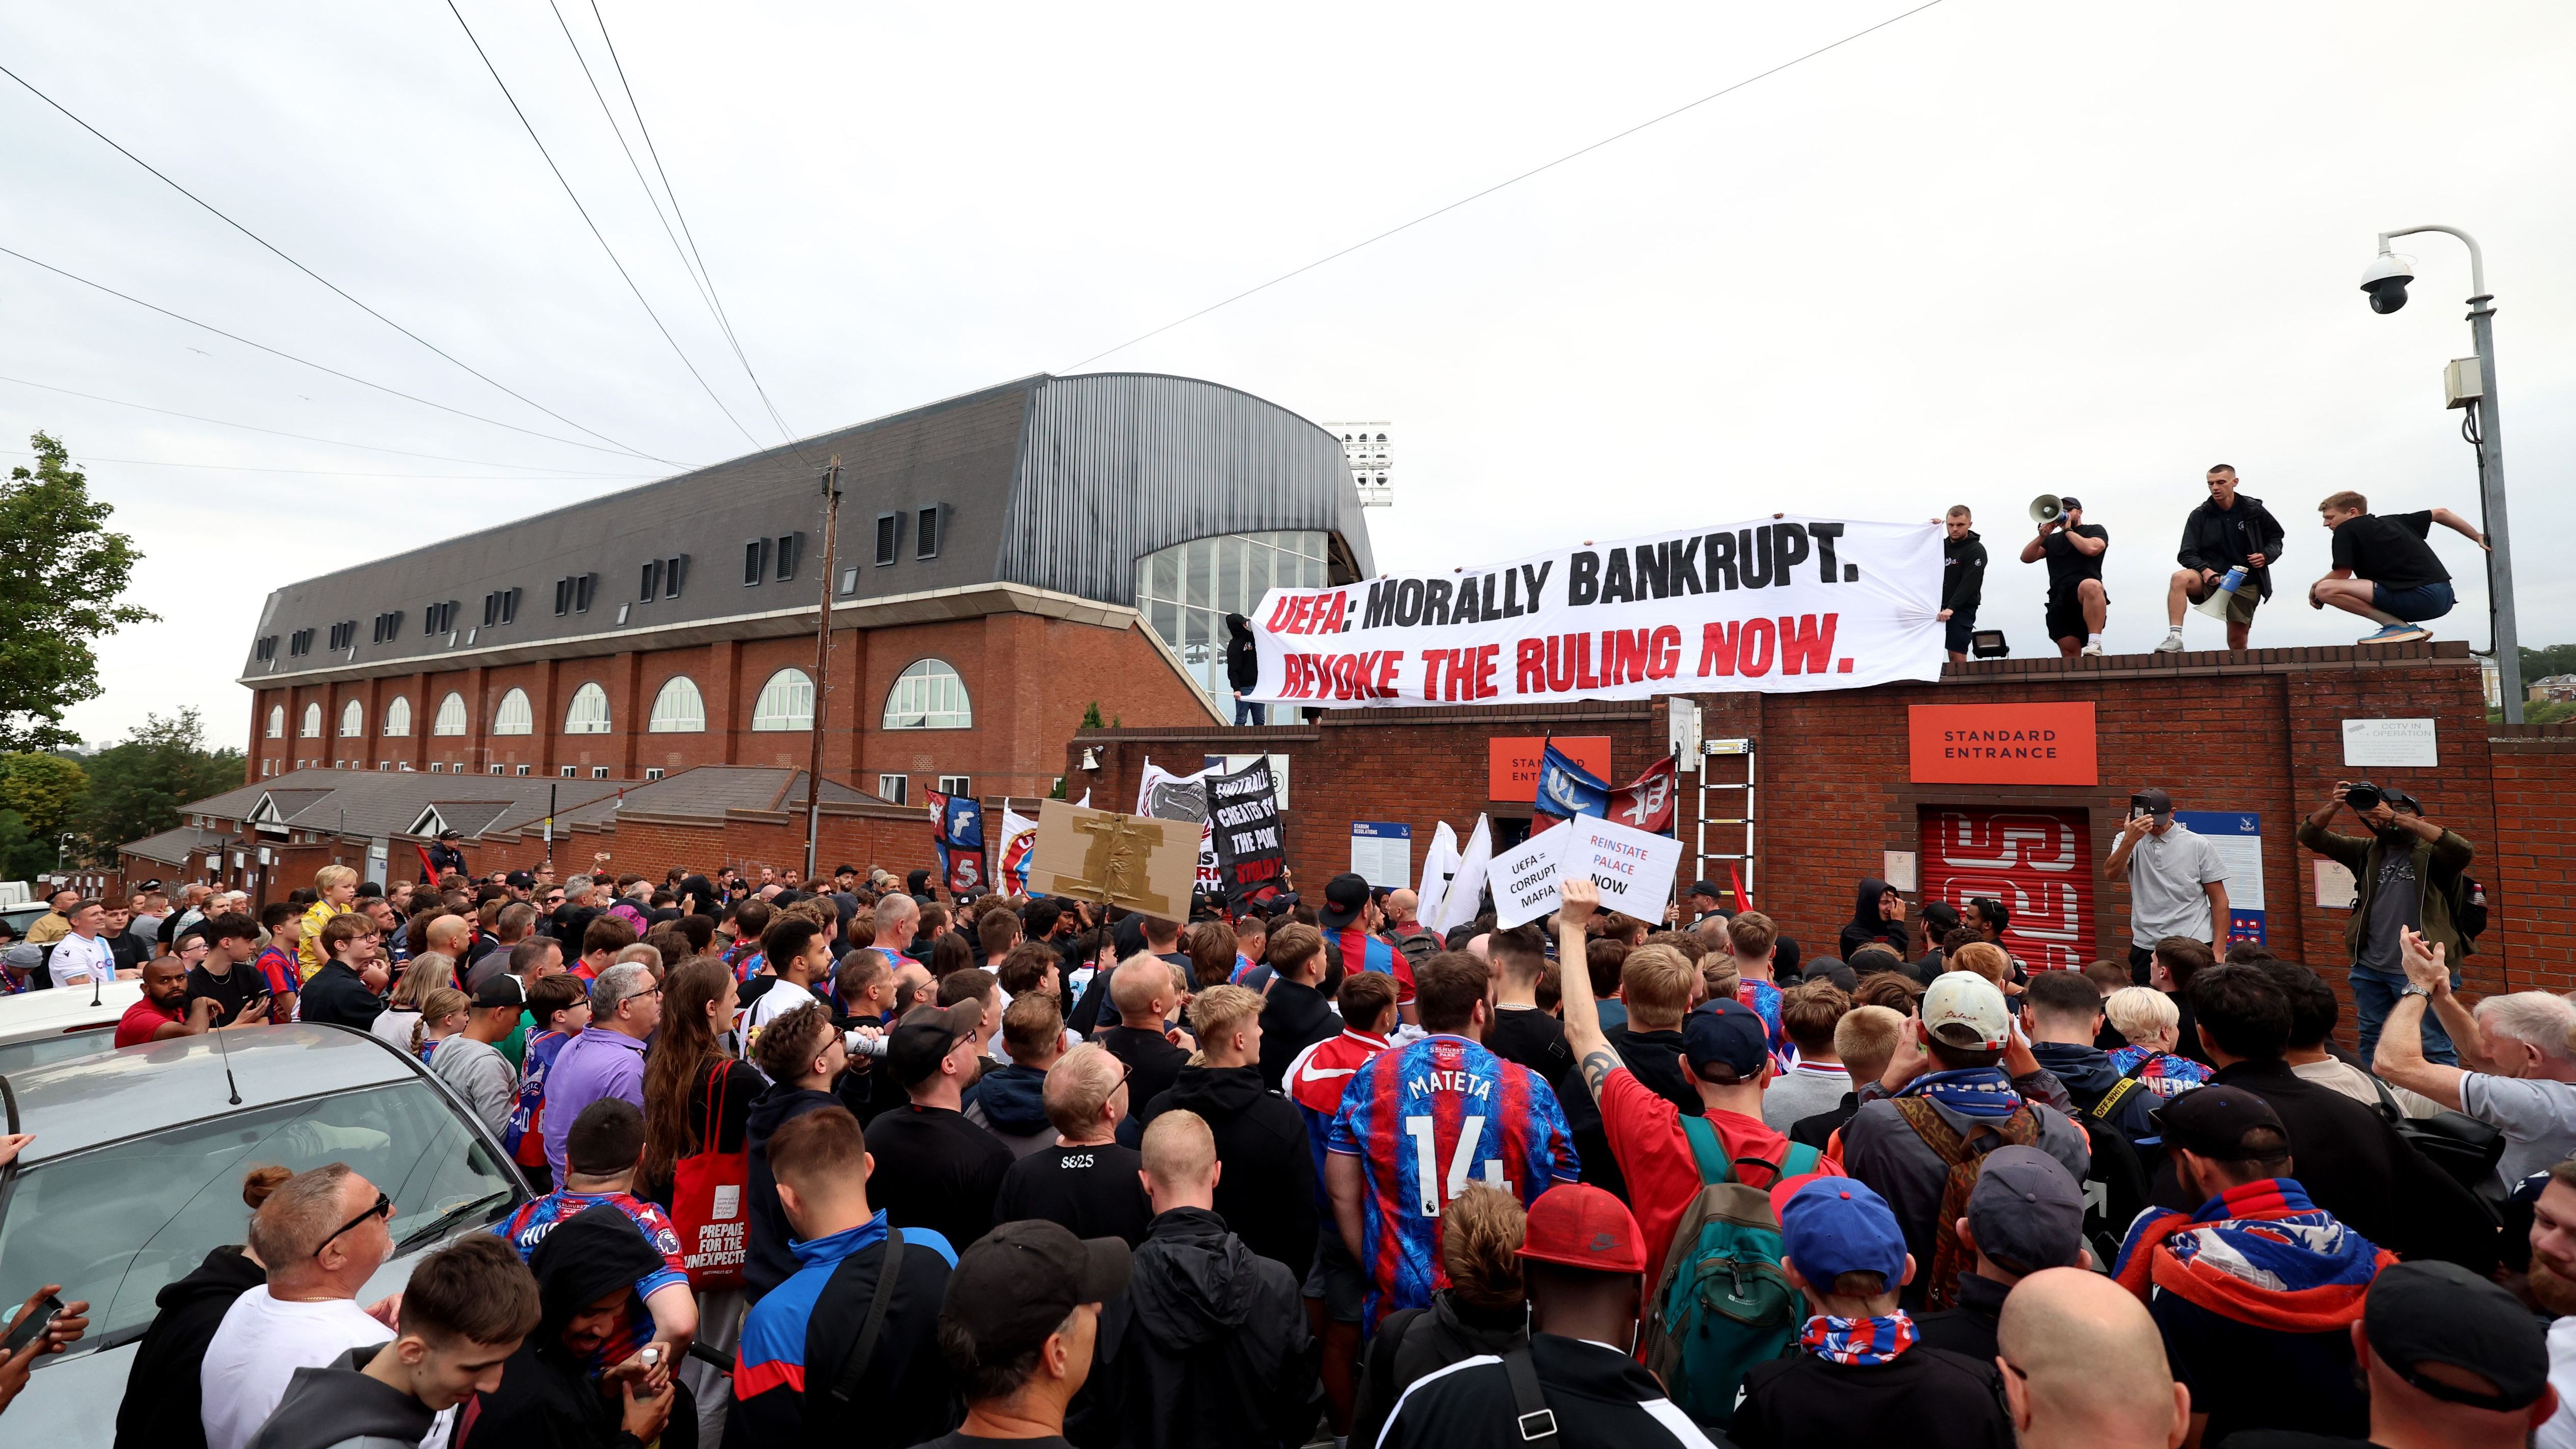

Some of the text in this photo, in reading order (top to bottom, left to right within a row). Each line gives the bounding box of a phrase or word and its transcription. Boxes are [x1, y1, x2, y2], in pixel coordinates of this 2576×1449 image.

[1266, 522, 1859, 634] UEFA: MORALLY BANKRUPT.
[1277, 613, 1854, 701] REVOKE THE RULING NOW.
[1945, 730, 2056, 742] STANDARD
[1512, 759, 1585, 768] STAND
[1945, 747, 2057, 758] ENTRANCE
[1215, 768, 1268, 799] FOOTBALL:
[1217, 801, 1264, 827] CREATED
[1231, 832, 1256, 855] THE
[1590, 835, 1649, 861] REINSTATE
[1512, 855, 1537, 875] U€FA
[1593, 854, 1635, 875] PALACE
[1510, 863, 1557, 894] CORRUPT
[1590, 873, 1628, 895] NOW
[1521, 884, 1556, 908] MAFIA
[1944, 1010, 1978, 1021] Palace
[1408, 1071, 1491, 1101] MATETA
[2096, 1082, 2127, 1116] OFF-WHITE
[1061, 1154, 1094, 1169] SE25
[1405, 1116, 1513, 1218] 14
[556, 1201, 590, 1210] SELHURST
[699, 1236, 742, 1253] FOR THE
[684, 1249, 747, 1269] UNEXPECTE
